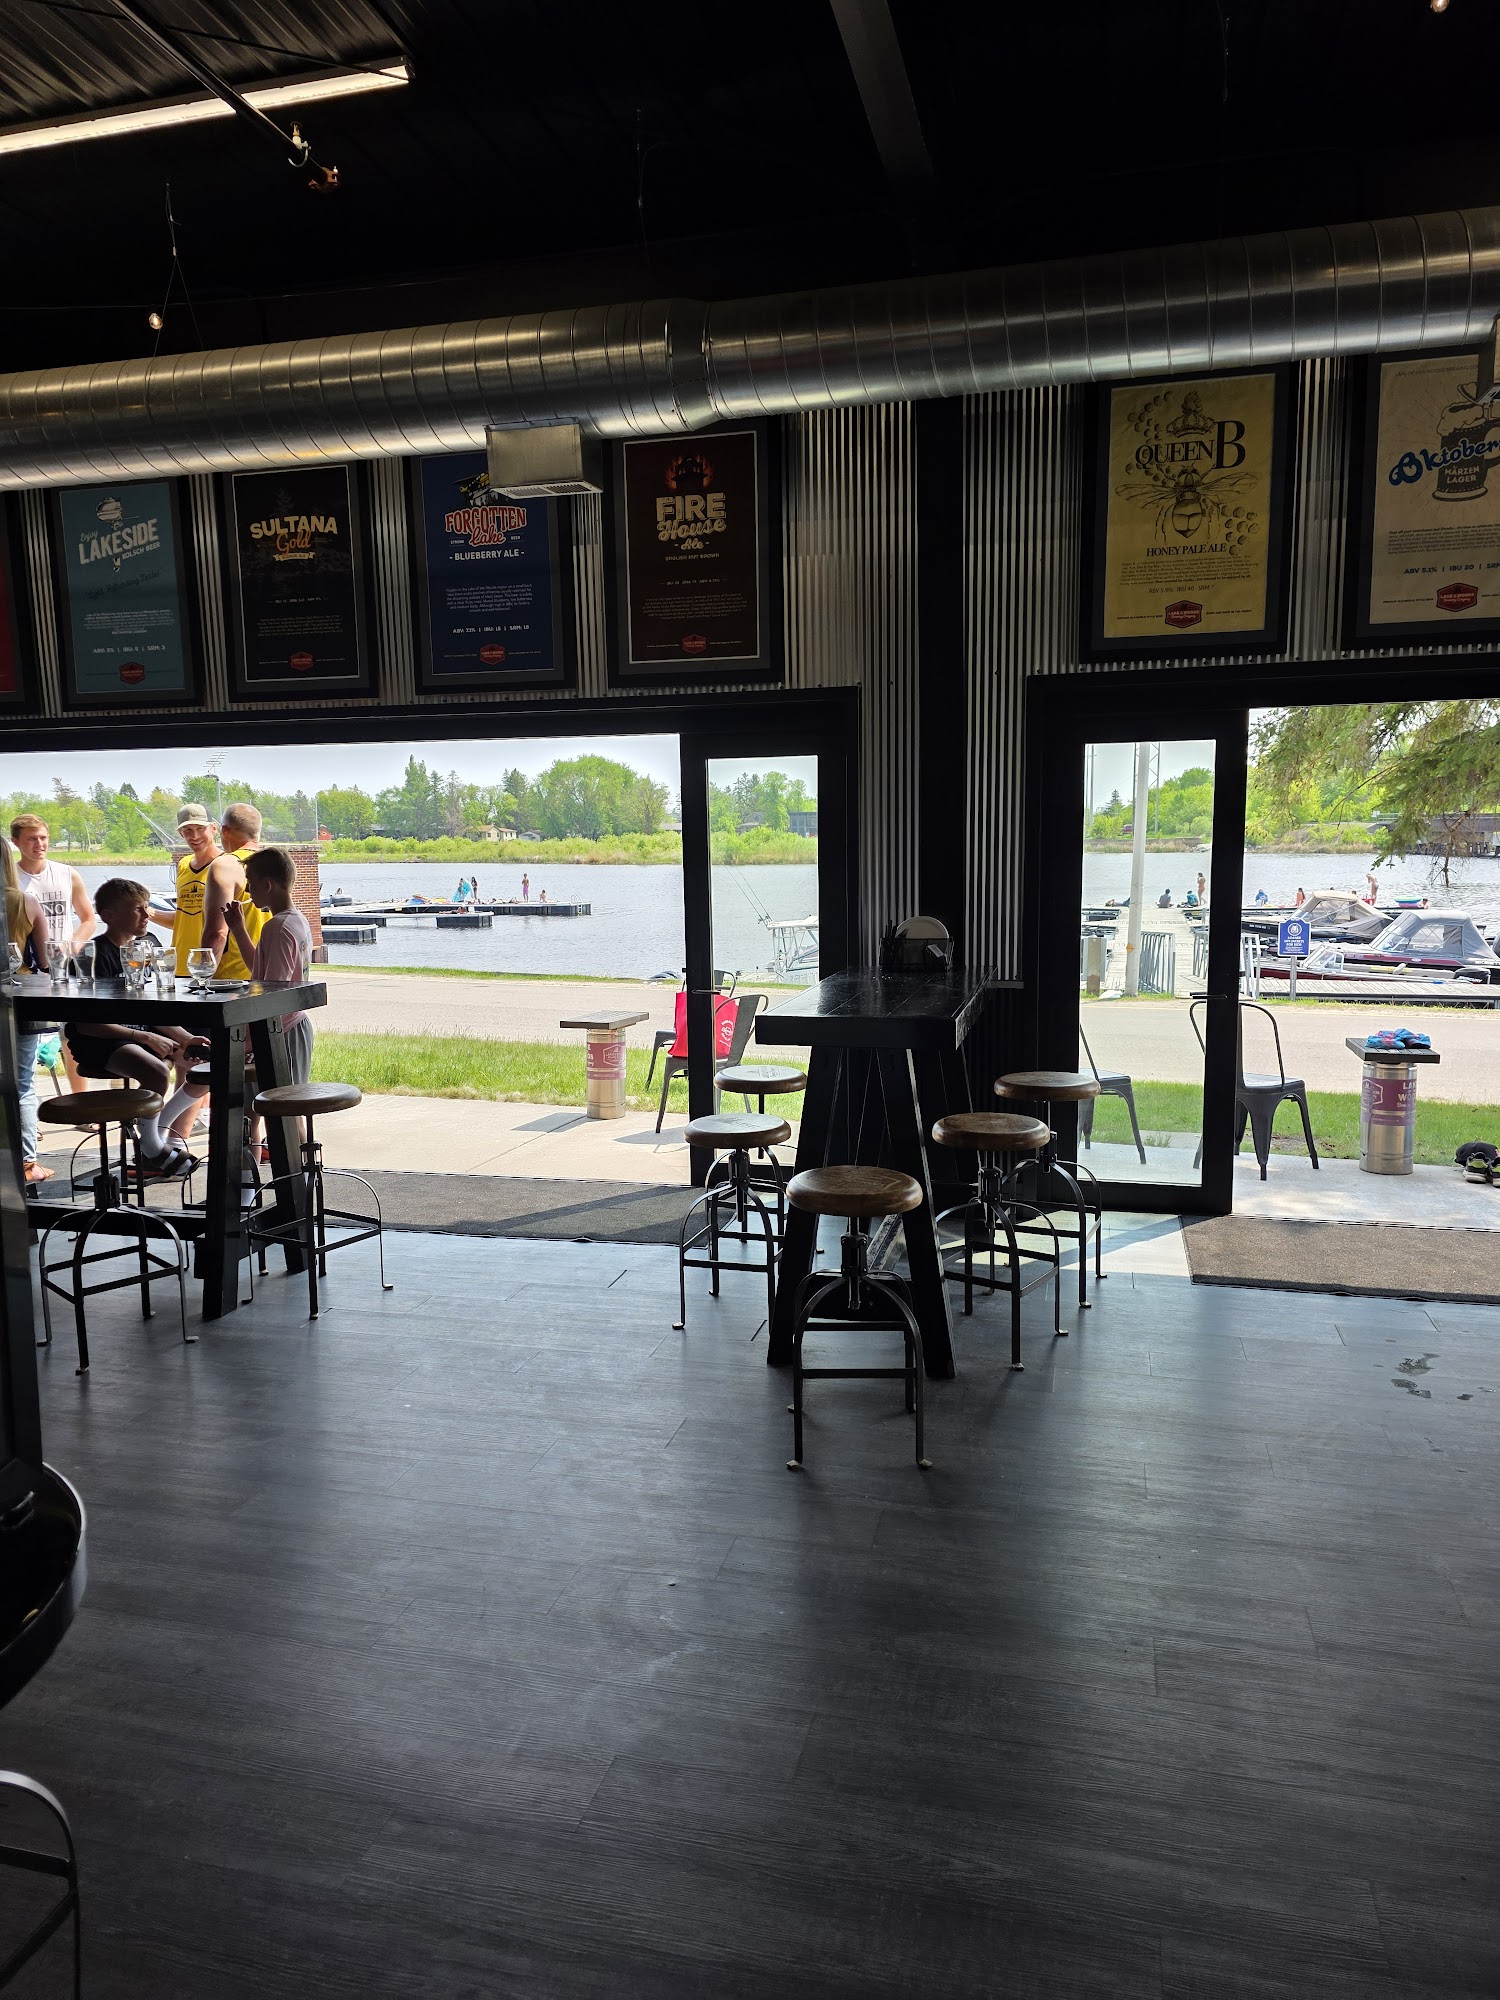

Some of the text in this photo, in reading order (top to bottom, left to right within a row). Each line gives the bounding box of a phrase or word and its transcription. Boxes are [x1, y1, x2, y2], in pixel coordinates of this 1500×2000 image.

[1136, 420, 1246, 471] QUEEN B
[1446, 474, 1477, 484] LAGER
[656, 492, 726, 522] FIRE
[249, 516, 338, 539] SULTANA
[444, 506, 527, 534] FORGOTTEN
[657, 518, 727, 541] House
[78, 518, 159, 564] LAKESIDE
[146, 542, 160, 552] BEER
[276, 528, 312, 554] Gold
[680, 538, 704, 550] Ale
[1146, 543, 1226, 557] HONEY PALE ALE
[454, 549, 519, 560] BLUEBERRY ALE
[26, 890, 62, 901] AITH
[50, 919, 64, 928] RE
